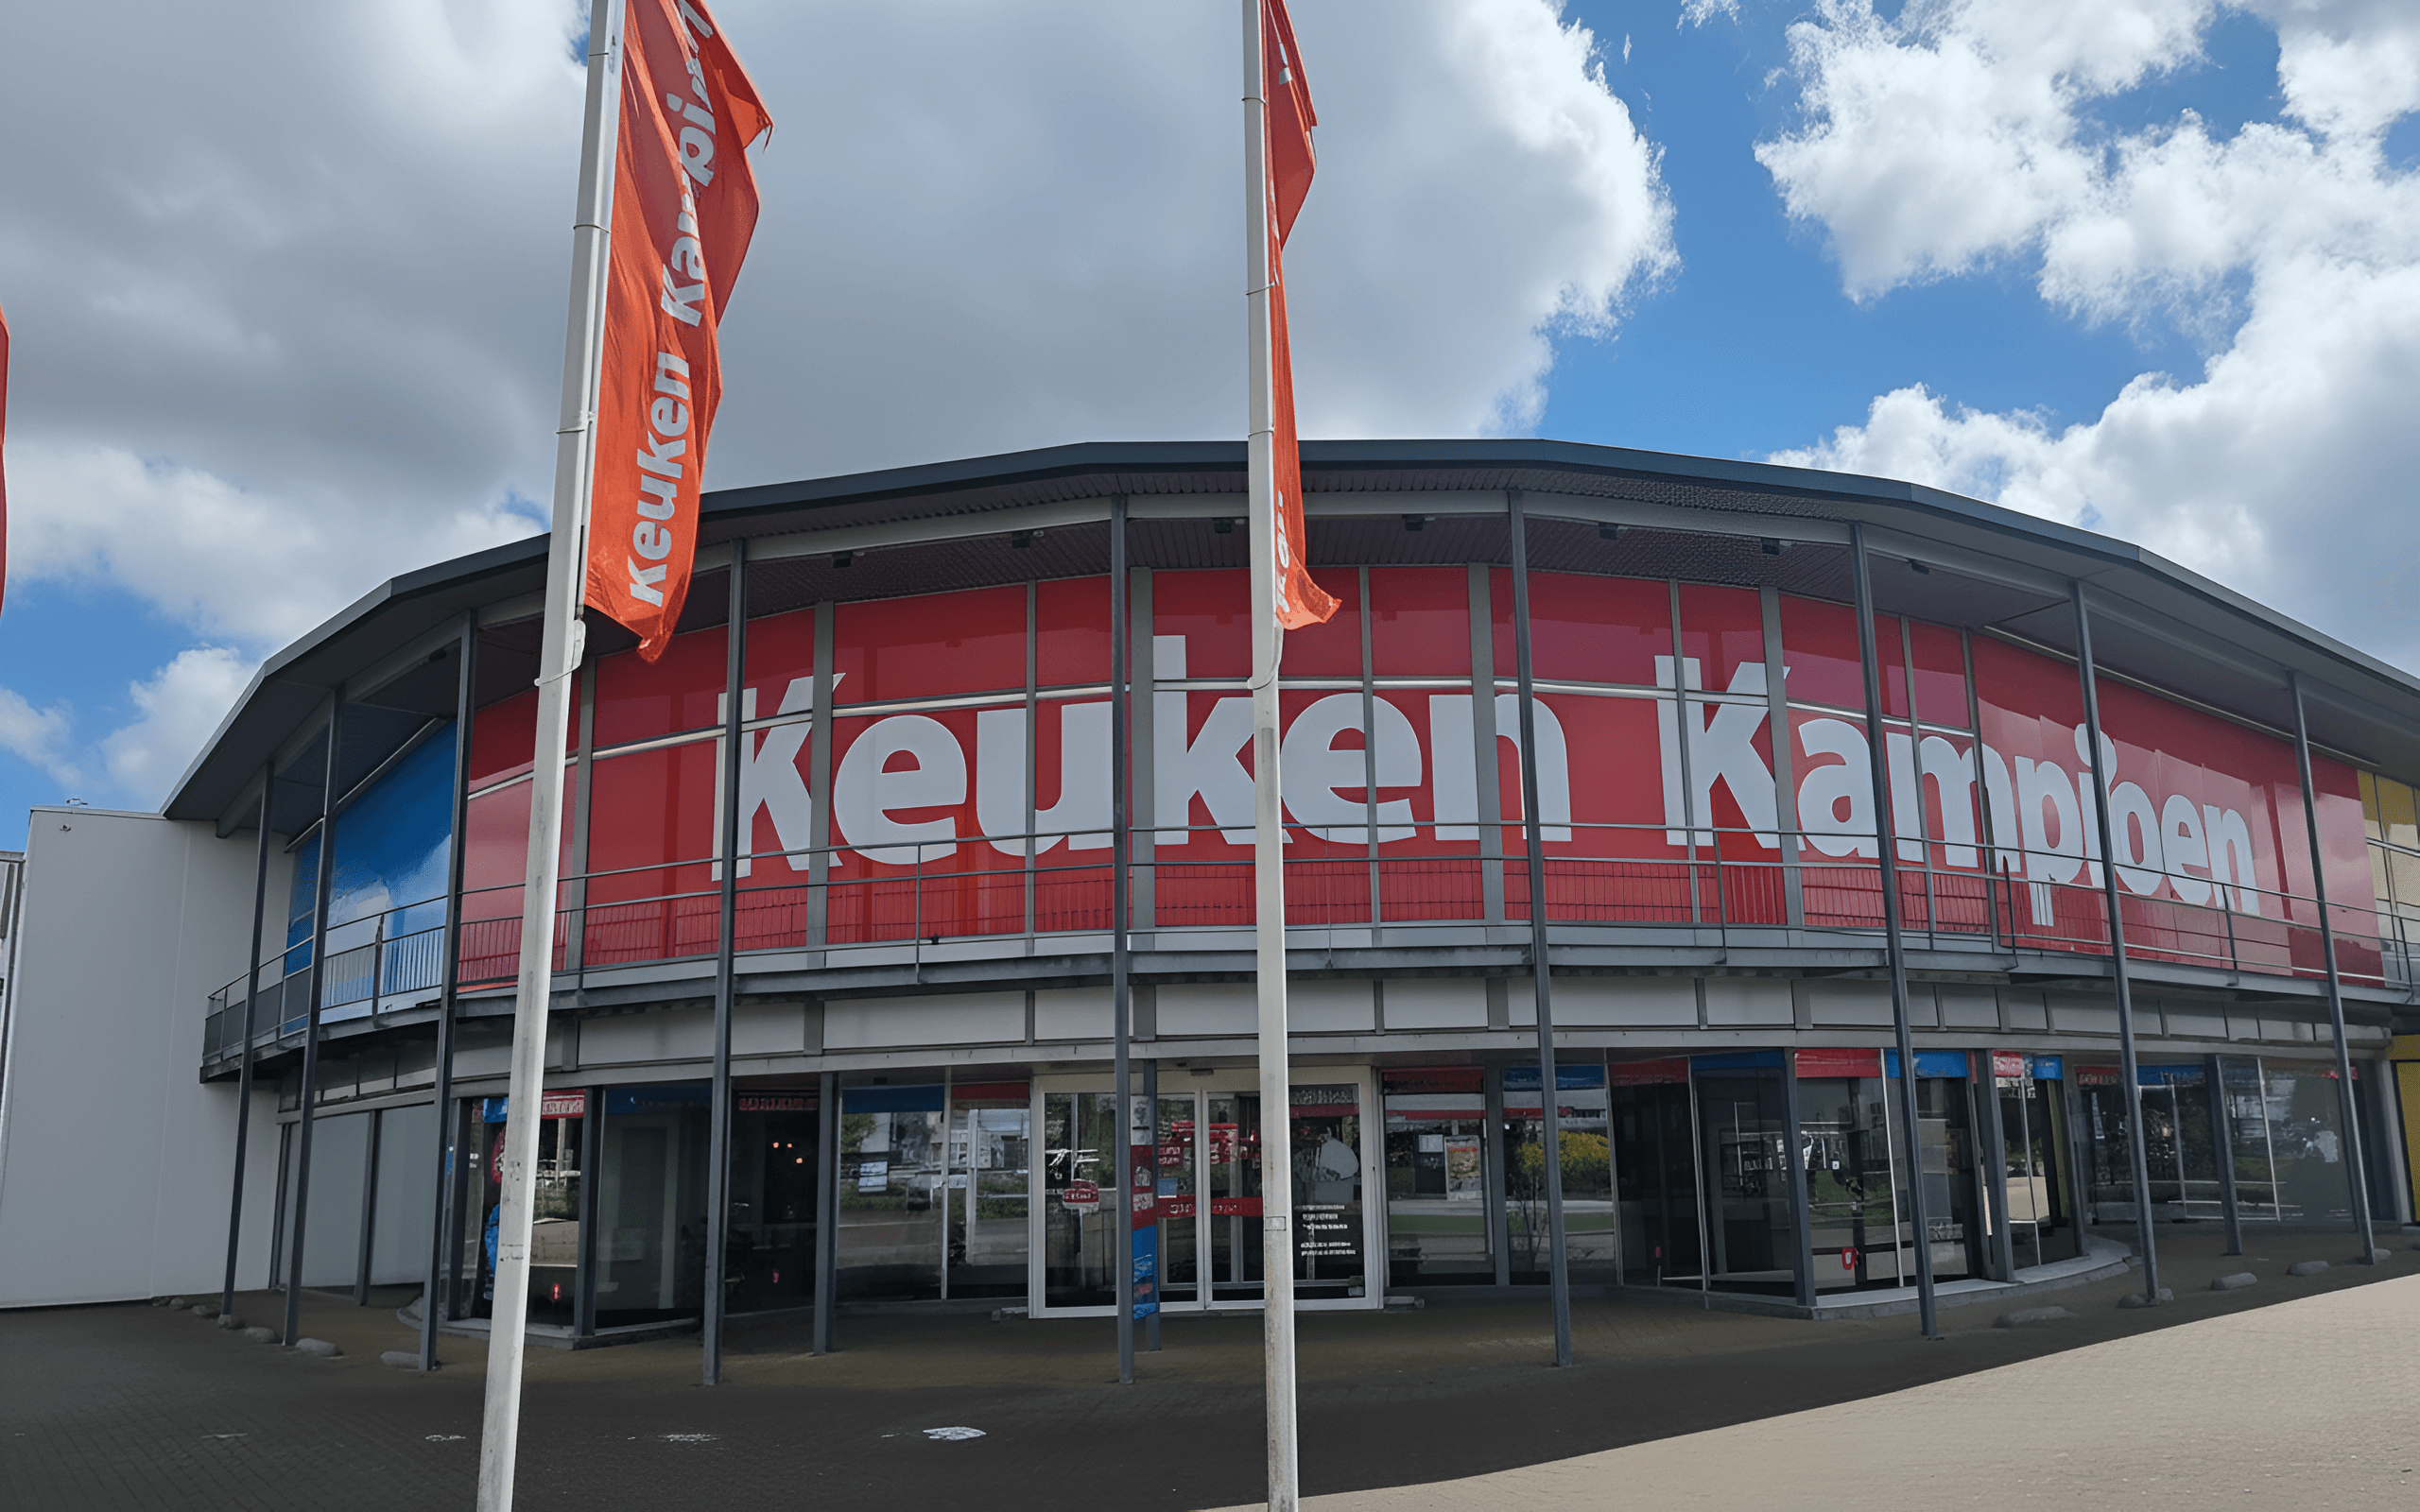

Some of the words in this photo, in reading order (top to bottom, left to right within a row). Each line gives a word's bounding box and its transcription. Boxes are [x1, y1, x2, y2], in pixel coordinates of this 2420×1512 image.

[627, 351, 690, 608] Keuken
[713, 635, 1571, 881] Keuken
[1654, 655, 2259, 926] Kampioen
